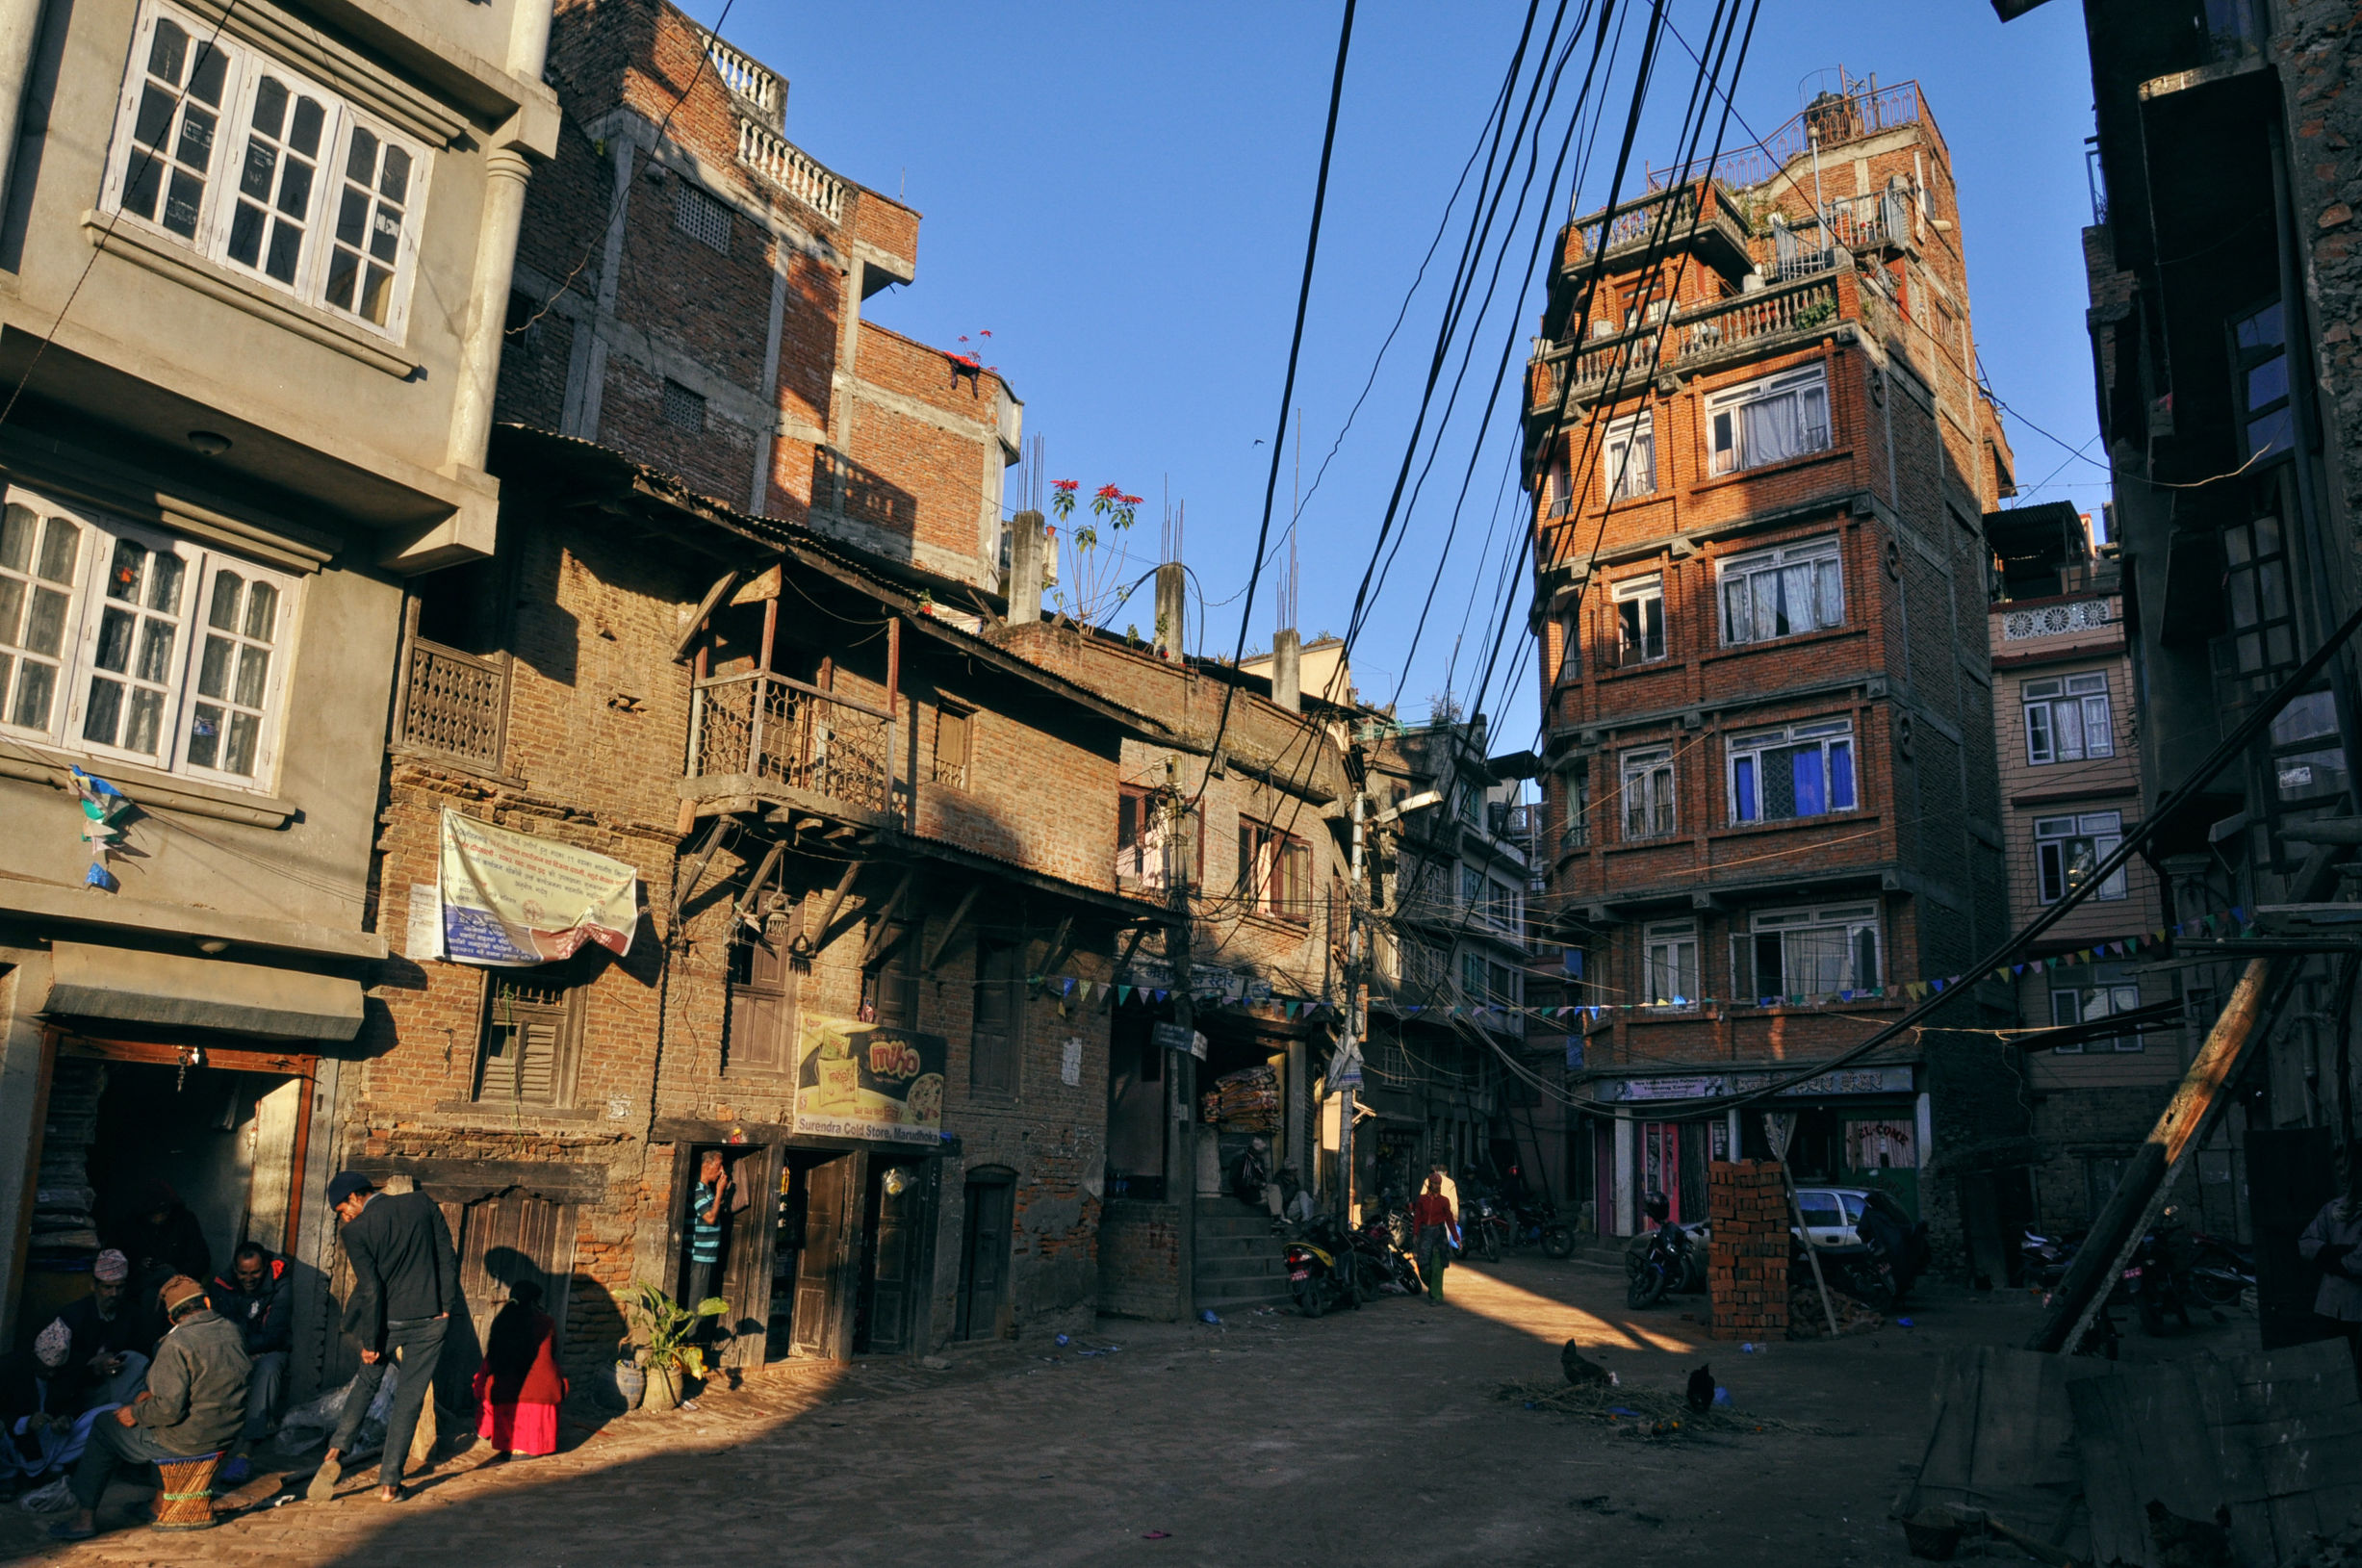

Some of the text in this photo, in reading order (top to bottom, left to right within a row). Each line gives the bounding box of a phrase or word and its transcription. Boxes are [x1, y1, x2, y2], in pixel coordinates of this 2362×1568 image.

[799, 1118, 841, 1133] Surendra
[843, 1122, 864, 1136] Cold
[866, 1125, 892, 1140] Store,
